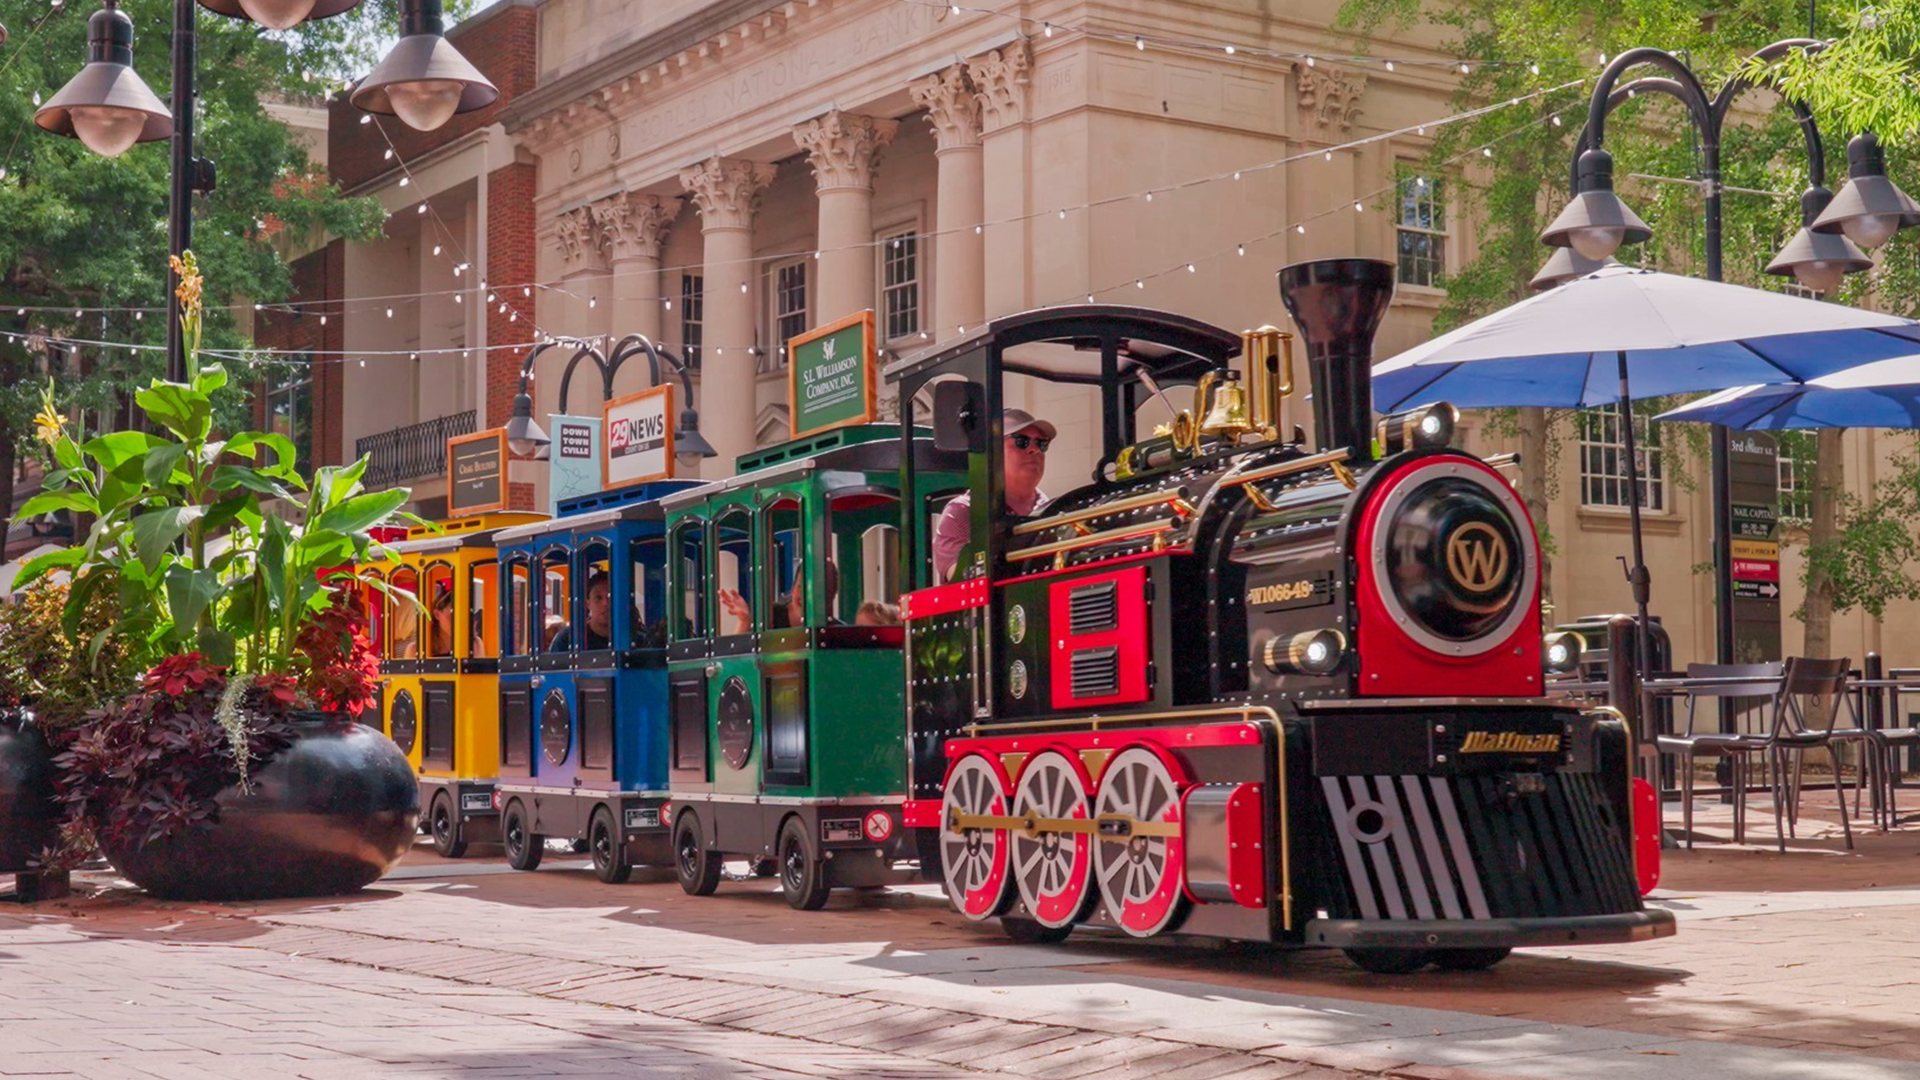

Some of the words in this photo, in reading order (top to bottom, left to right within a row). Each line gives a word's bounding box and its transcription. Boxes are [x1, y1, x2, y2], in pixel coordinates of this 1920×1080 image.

[724, 38, 836, 107] NATIONAL
[853, 5, 920, 56] BANK
[1048, 69, 1072, 92] 1916
[815, 355, 858, 380] WILLIAMSON
[562, 427, 589, 437] DOWN
[562, 438, 589, 446] TOWN
[1731, 439, 1744, 452] 3rd
[562, 446, 589, 455] CVILLE
[1733, 507, 1749, 518] NAIL
[1749, 508, 1775, 520] CAPITAL
[1452, 535, 1503, 586] W
